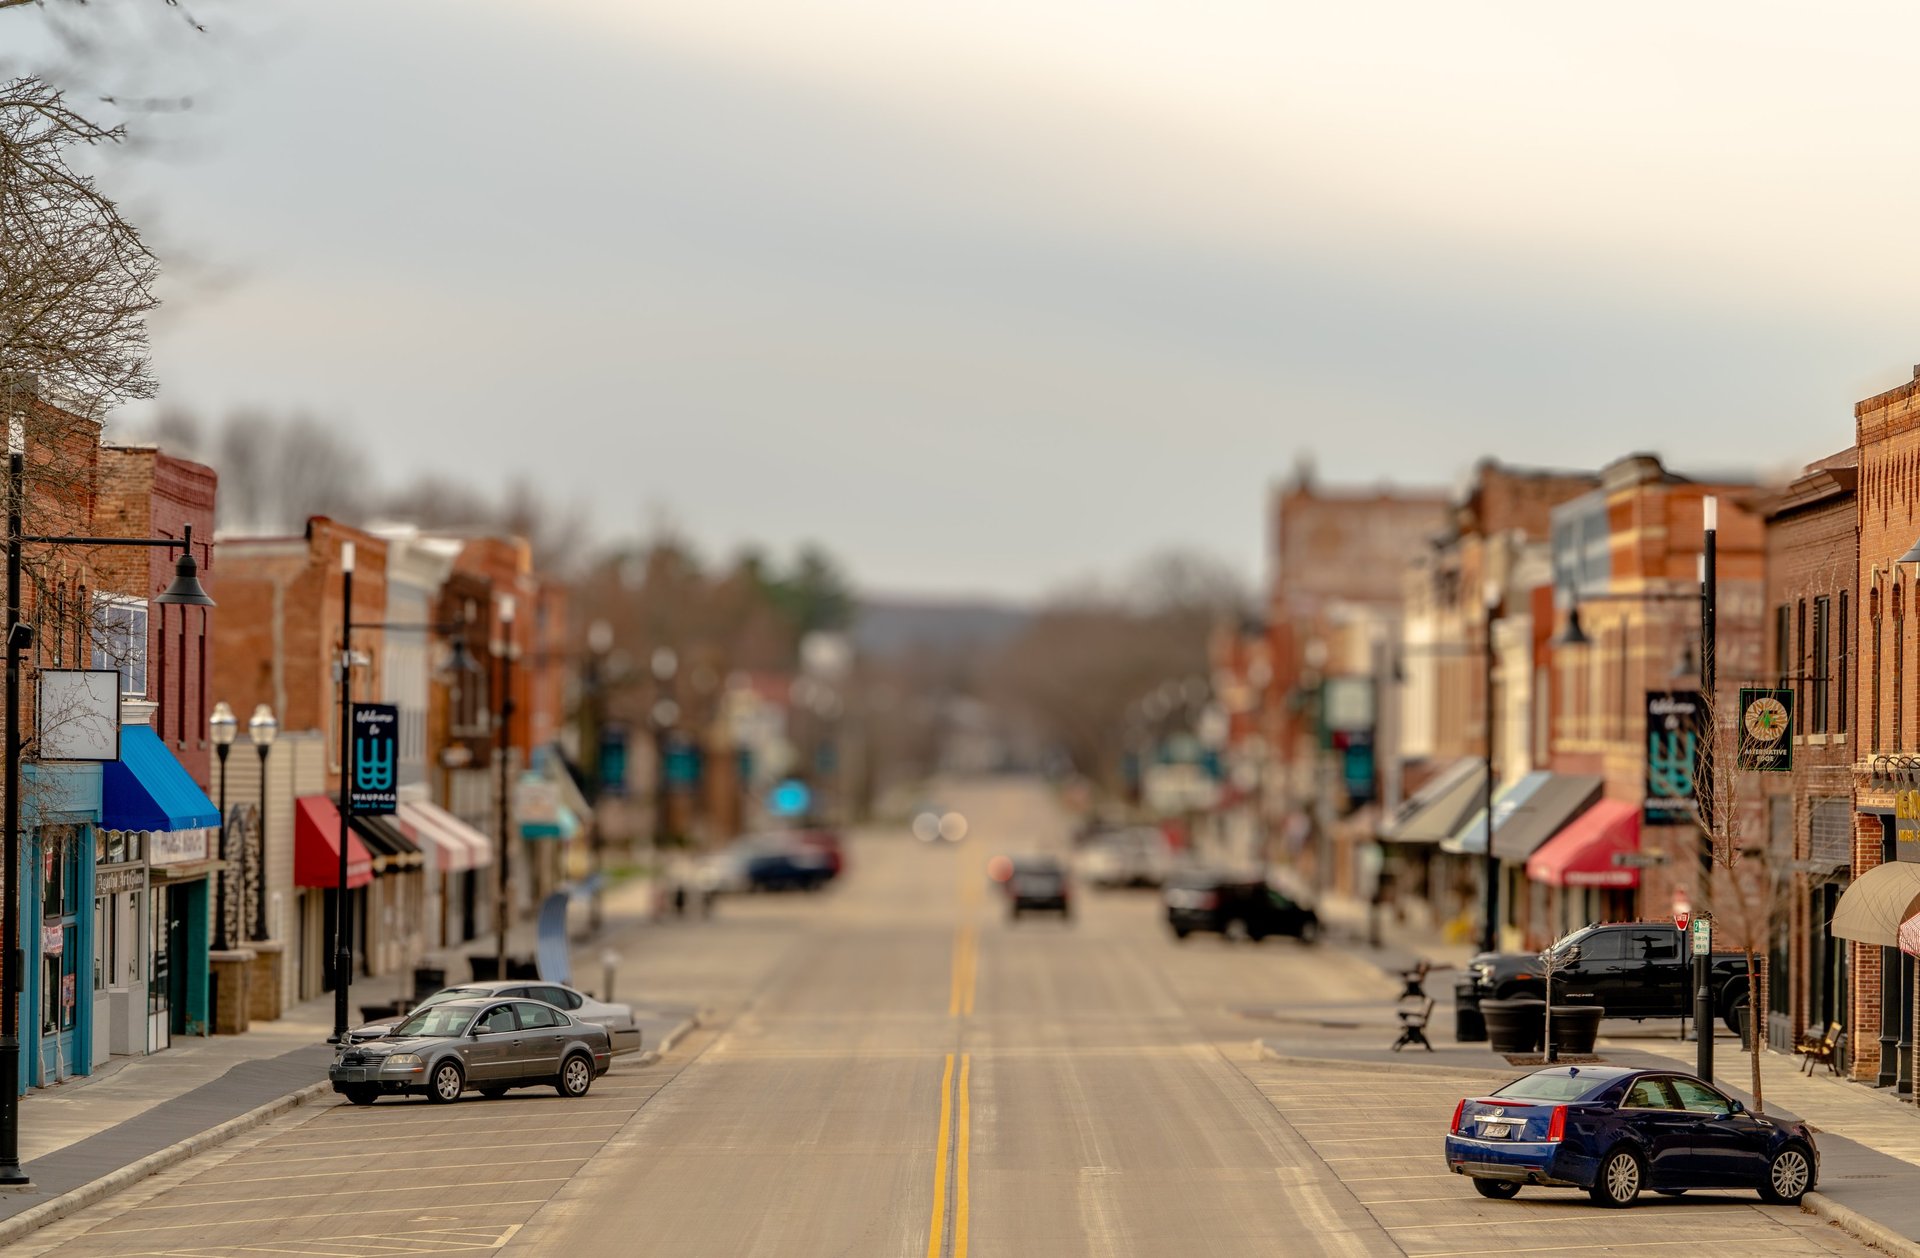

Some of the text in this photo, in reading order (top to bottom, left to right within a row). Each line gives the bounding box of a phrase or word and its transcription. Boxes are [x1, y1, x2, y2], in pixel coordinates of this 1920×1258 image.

[356, 709, 394, 723] Welcome
[369, 723, 380, 736] to
[352, 793, 396, 801] WAUPACA
